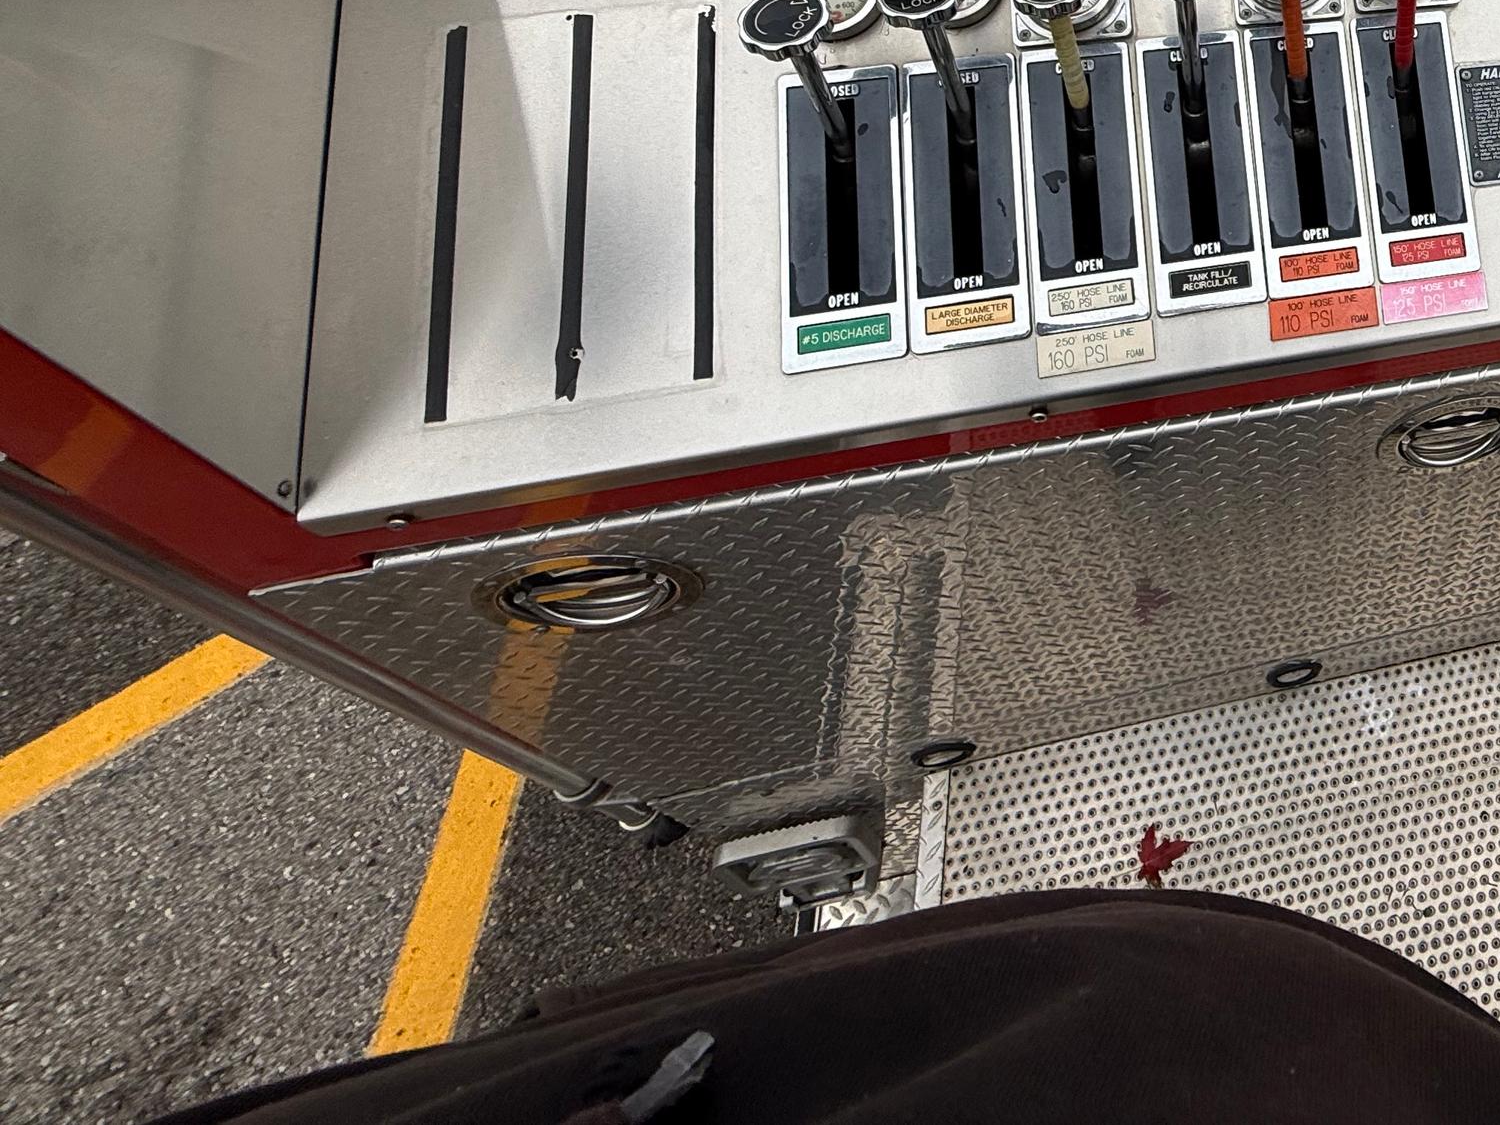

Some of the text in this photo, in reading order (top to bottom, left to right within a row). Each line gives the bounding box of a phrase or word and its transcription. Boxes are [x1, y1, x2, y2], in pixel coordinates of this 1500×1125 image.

[842, 1, 855, 9] 600
[785, 6, 818, 37] LOCK
[1412, 213, 1437, 227] OPEN
[1302, 227, 1330, 241] OPEN
[1194, 241, 1221, 256] OPEN
[1392, 237, 1460, 253] 150' HOSE LINE
[1284, 251, 1353, 267] 100' HOSE LINE
[1402, 247, 1461, 263] 125 PSI FOAM
[1075, 258, 1104, 273] OPEN
[1292, 261, 1354, 277] 110 PSI FOAM
[954, 275, 984, 291] OPEN
[1182, 275, 1238, 291] RECIRCULATE
[1188, 268, 1232, 282] TANK FILL/
[1051, 283, 1127, 302] 250' HOSE LINE
[1420, 279, 1468, 292] HOSE LINE
[828, 291, 859, 309] OPEN
[1060, 294, 1128, 311] 160 PSI FOAM
[1288, 294, 1358, 311] 100' HOSE LINE
[1392, 293, 1446, 317] 125 PSI
[932, 302, 1008, 321] LARGE DIAMETER
[946, 313, 994, 327] DISCHARGE
[1280, 309, 1369, 334] 110 PSI FOAM
[802, 323, 886, 345] #5 DISCHARGE
[1056, 327, 1136, 348] 250' HOSE LINE
[1048, 343, 1145, 371] 160 PSI FOAM
